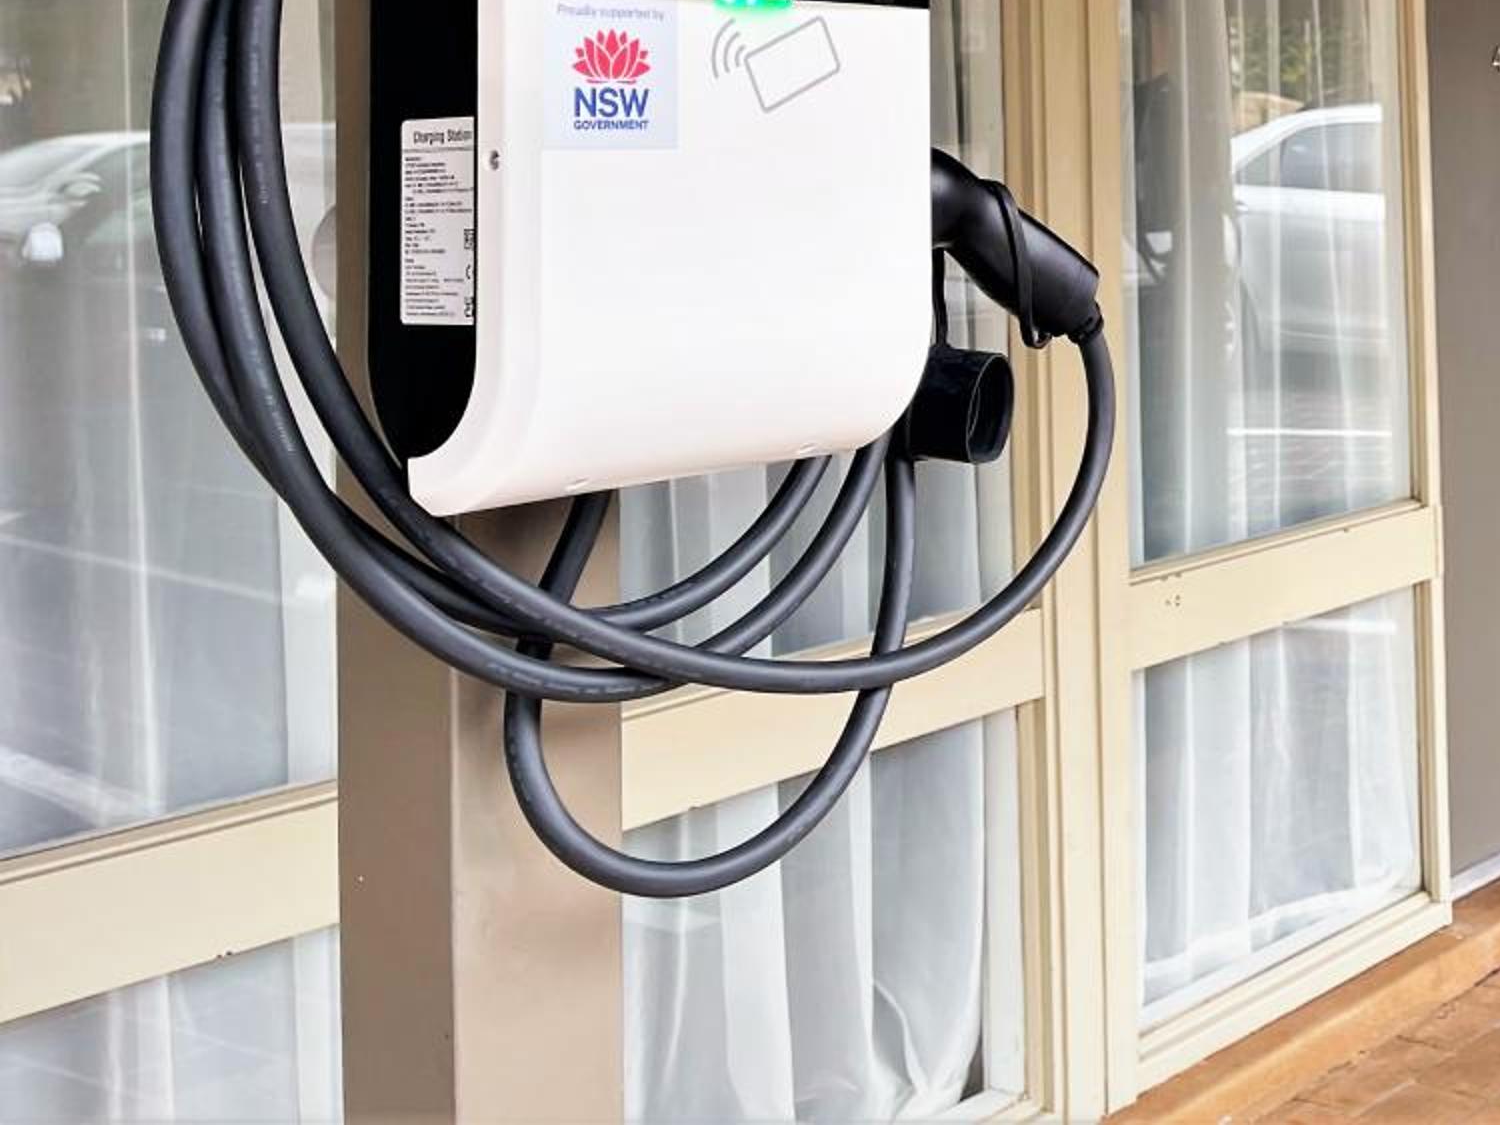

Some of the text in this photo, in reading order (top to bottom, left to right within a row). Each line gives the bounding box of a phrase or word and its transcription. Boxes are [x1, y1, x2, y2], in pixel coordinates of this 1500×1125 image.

[556, 3, 665, 22] Proudly supported by
[573, 87, 650, 118] NSW
[573, 120, 650, 131] GOVERNMENT
[413, 130, 445, 145] Charging
